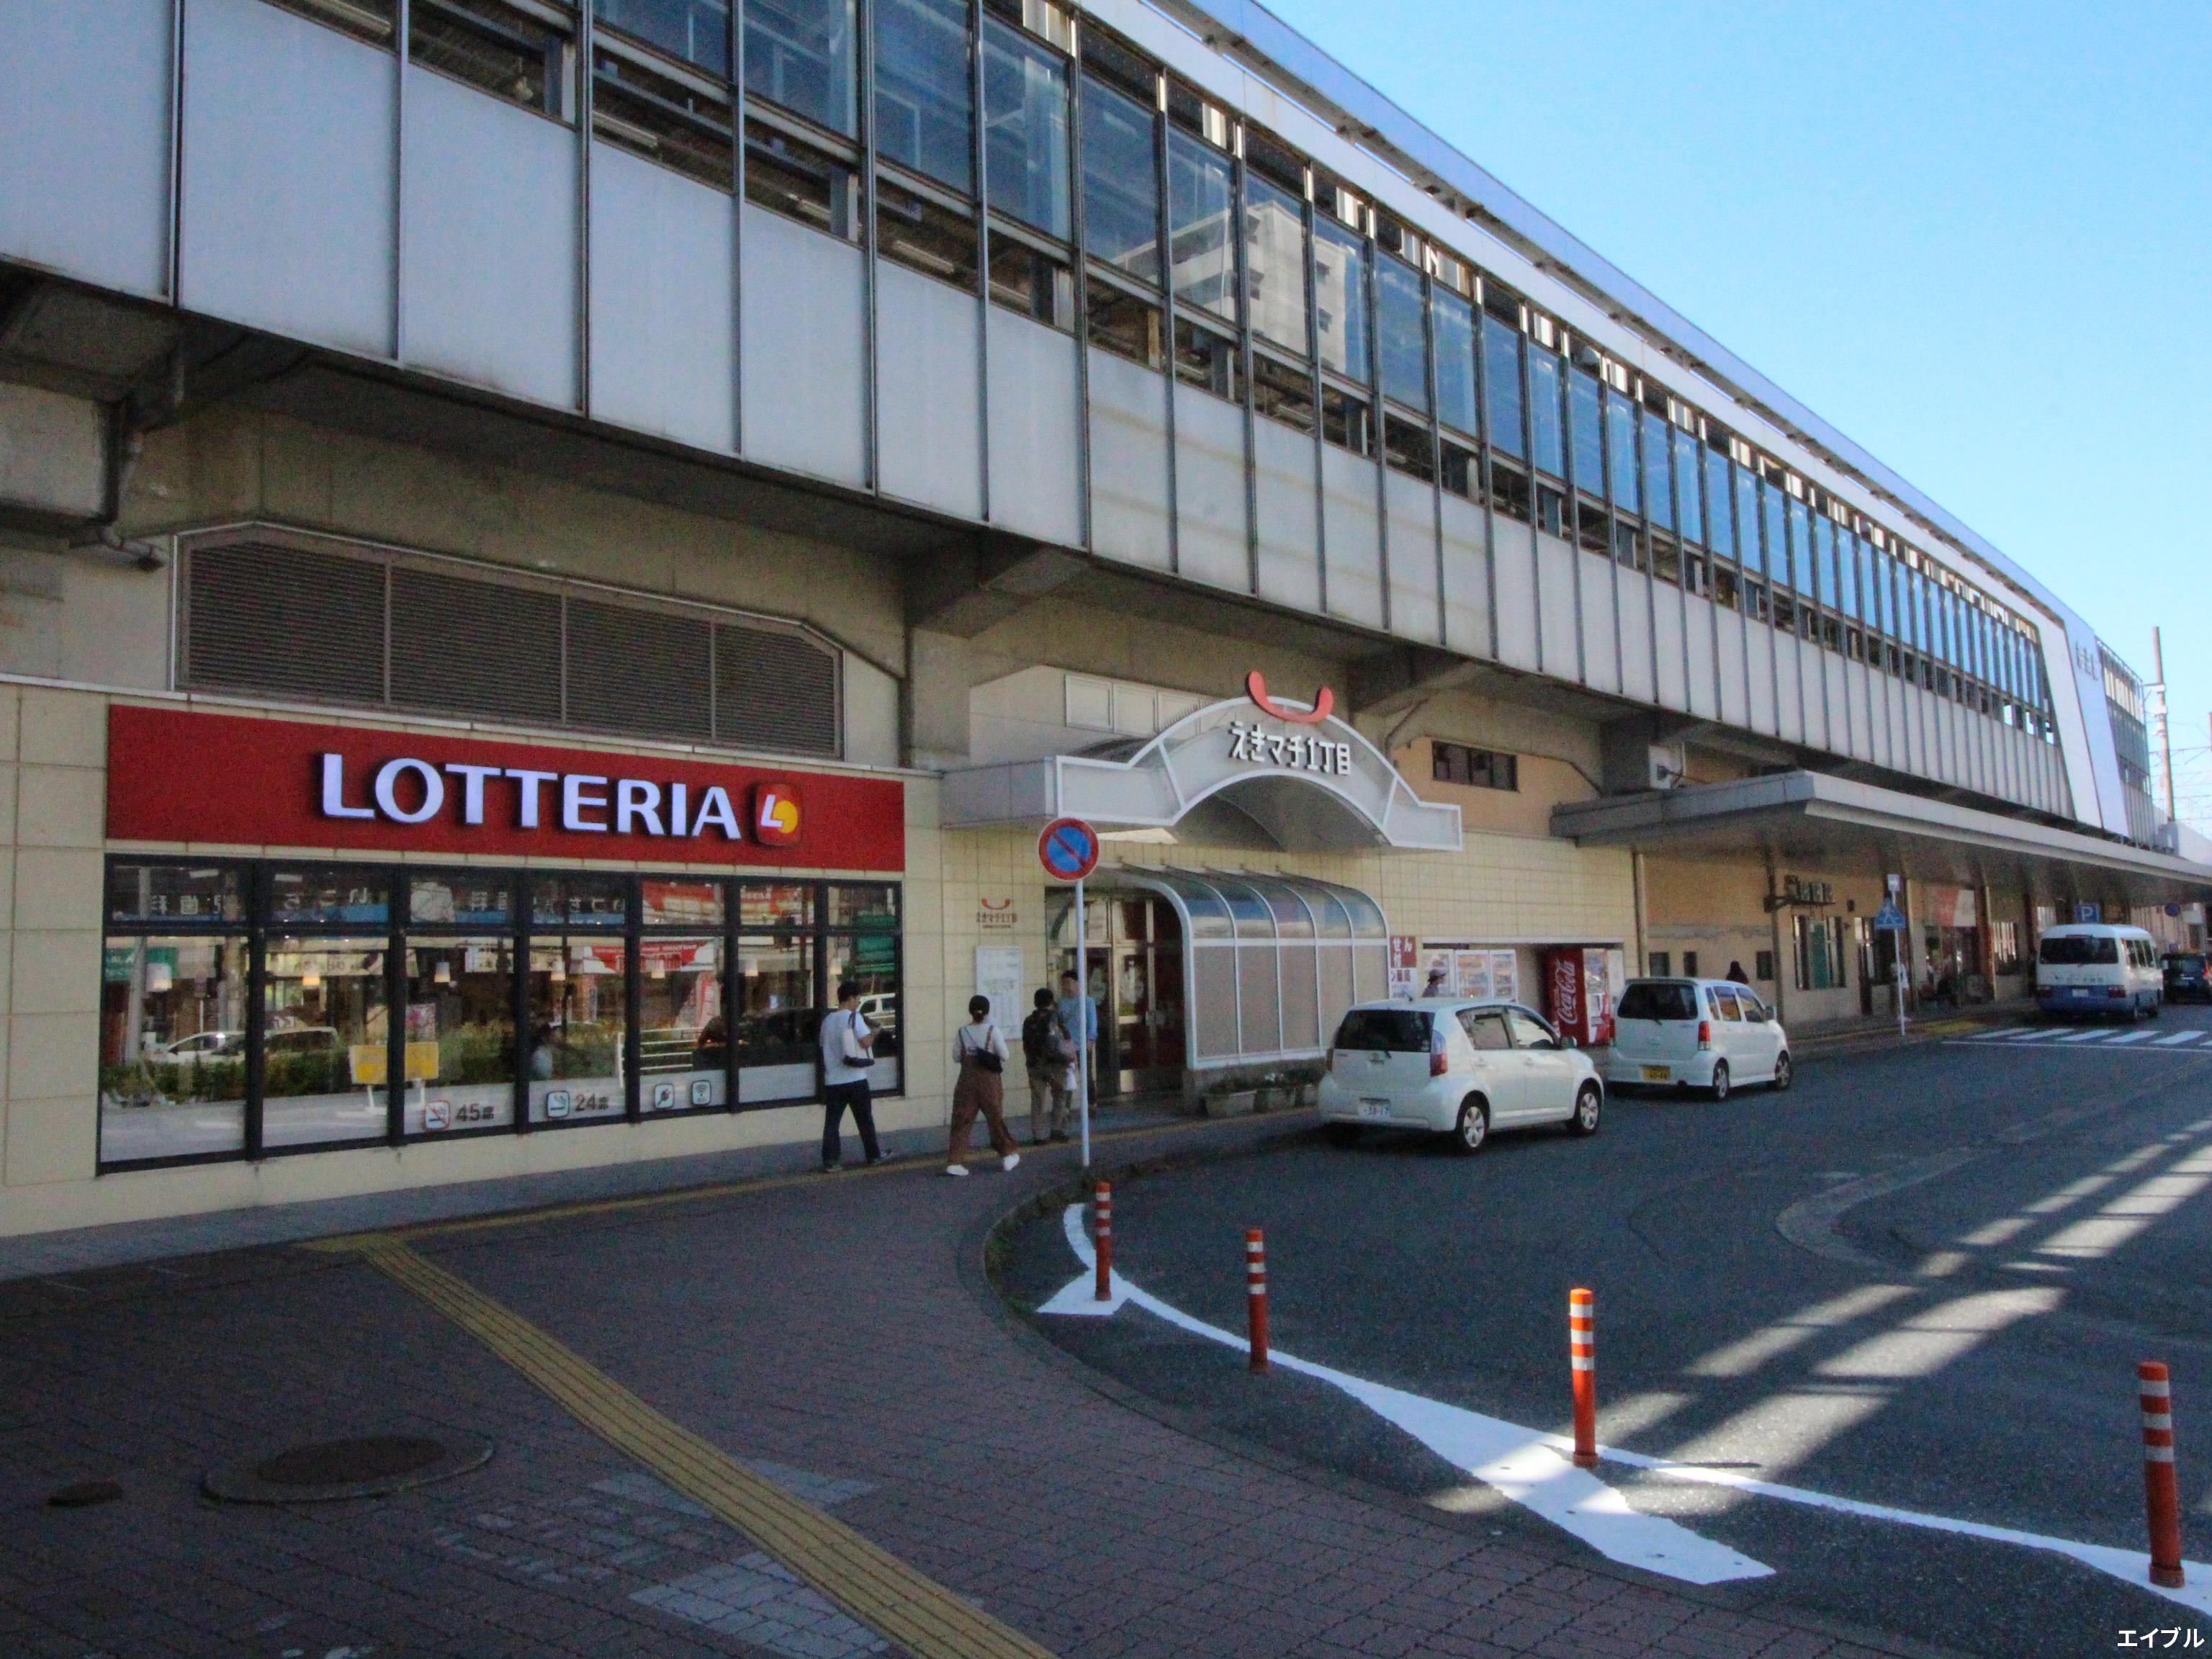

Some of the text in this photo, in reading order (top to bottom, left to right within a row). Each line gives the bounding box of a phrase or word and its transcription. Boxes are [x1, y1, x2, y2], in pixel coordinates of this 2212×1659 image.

[1230, 721, 1351, 775] えきマチ1丁目
[322, 752, 742, 840] LOTTERIA
[2081, 907, 2093, 922] P
